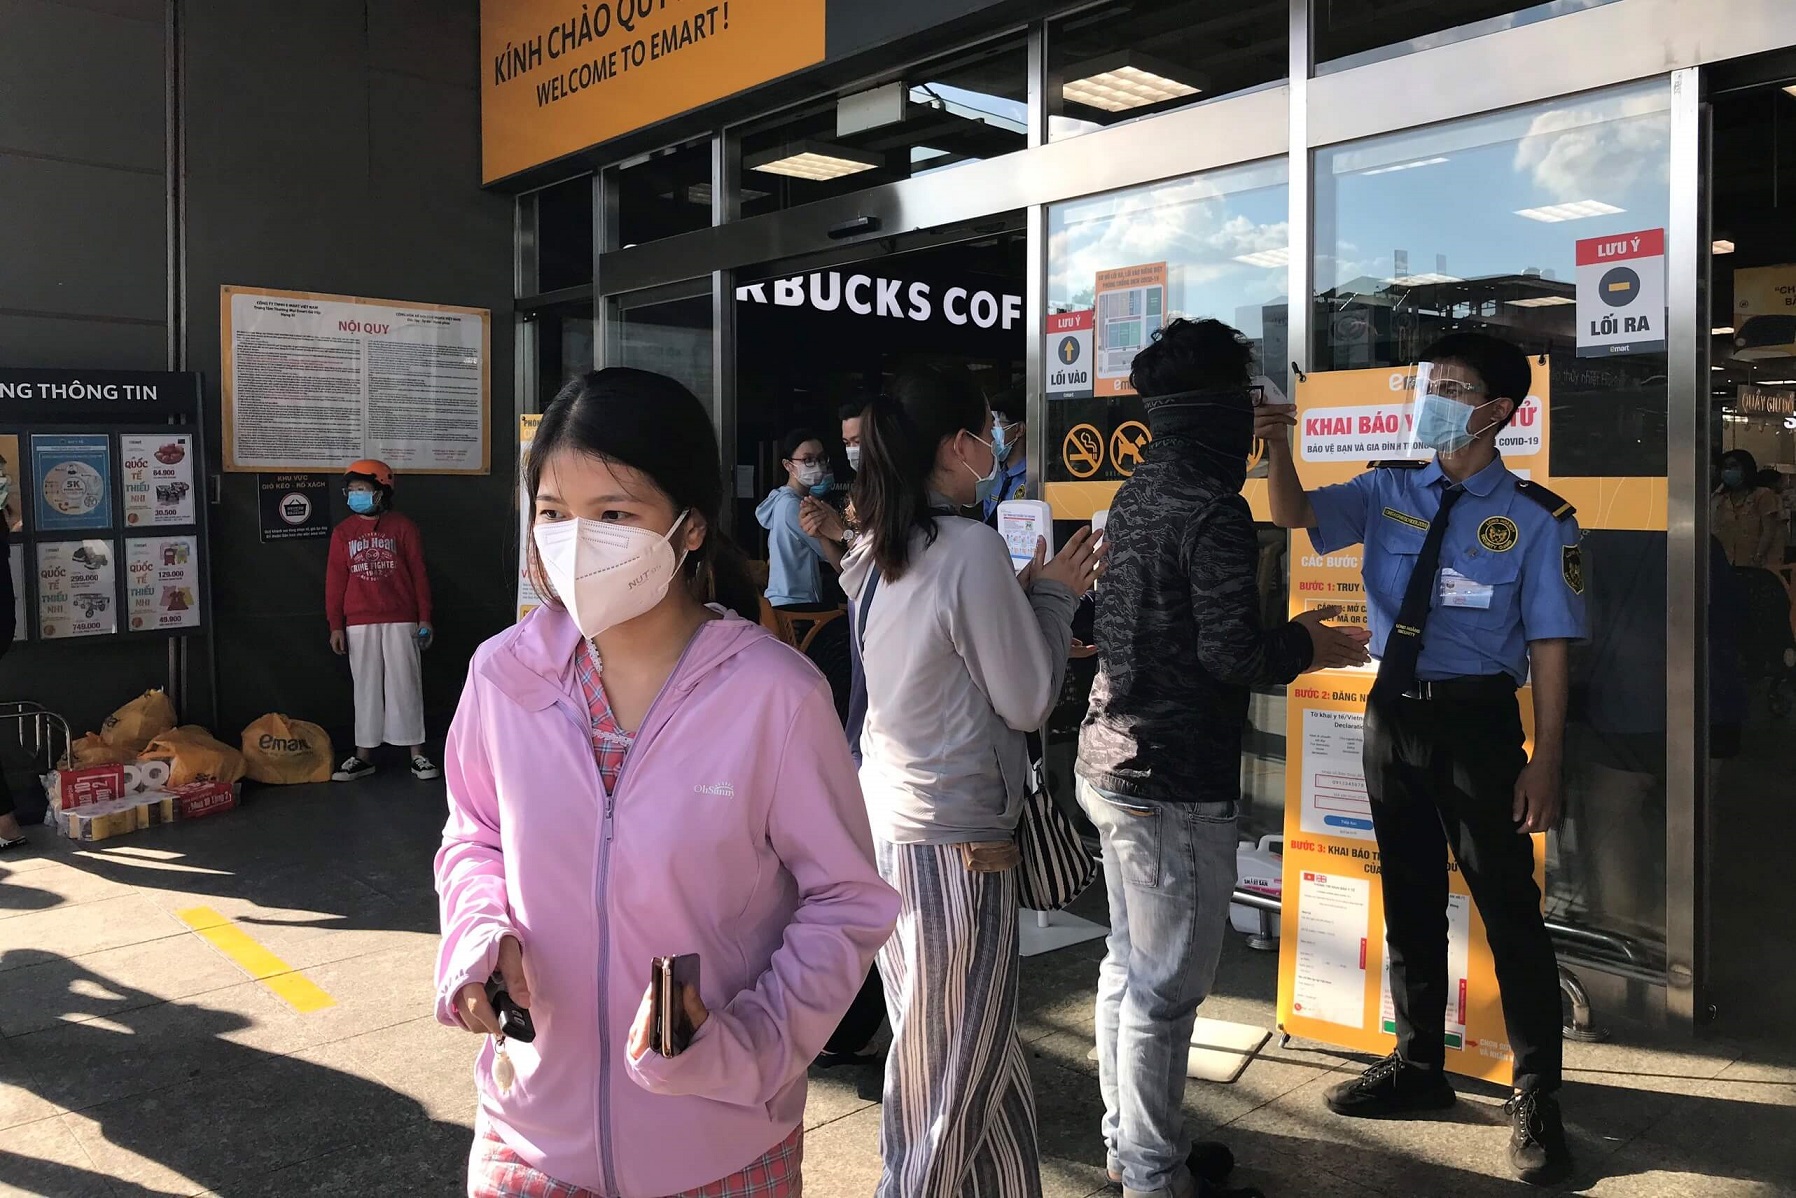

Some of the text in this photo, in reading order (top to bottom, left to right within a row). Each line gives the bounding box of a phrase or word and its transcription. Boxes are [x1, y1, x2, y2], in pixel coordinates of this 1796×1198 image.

[495, 35, 542, 86] KÍNH
[548, 3, 611, 59] CHÀO
[536, 51, 617, 107] WELCOME
[621, 40, 645, 71] TO
[651, 6, 718, 61] EMART
[1598, 236, 1641, 258] LƯU Ý
[338, 319, 390, 335] NỘI QUY
[1058, 315, 1081, 328] LƯU Ý
[1591, 312, 1650, 336] LỐI RA
[1610, 345, 1630, 353] emart
[1050, 371, 1087, 386] LỐI VÀO
[37, 380, 119, 400] THÔNG
[122, 384, 158, 400] TIN
[1306, 416, 1352, 436] KHAI
[1358, 410, 1399, 435] BÁO
[1366, 443, 1380, 452] GIA
[1498, 436, 1539, 447] COVID-19
[67, 480, 80, 488] 5K
[1326, 556, 1358, 568] BƯỚC
[628, 569, 650, 590] NUT
[1299, 581, 1360, 592] BƯỚC 1: TRUY
[1350, 616, 1361, 624] QR
[1294, 689, 1319, 699] BƯỚC
[1322, 691, 1330, 700] 2:
[1332, 690, 1357, 702] ĐĂNG
[1290, 839, 1315, 850] BƯỚC
[1317, 844, 1326, 853] 3:
[1328, 845, 1349, 857] KHAI
[1351, 845, 1370, 860] BÁO
